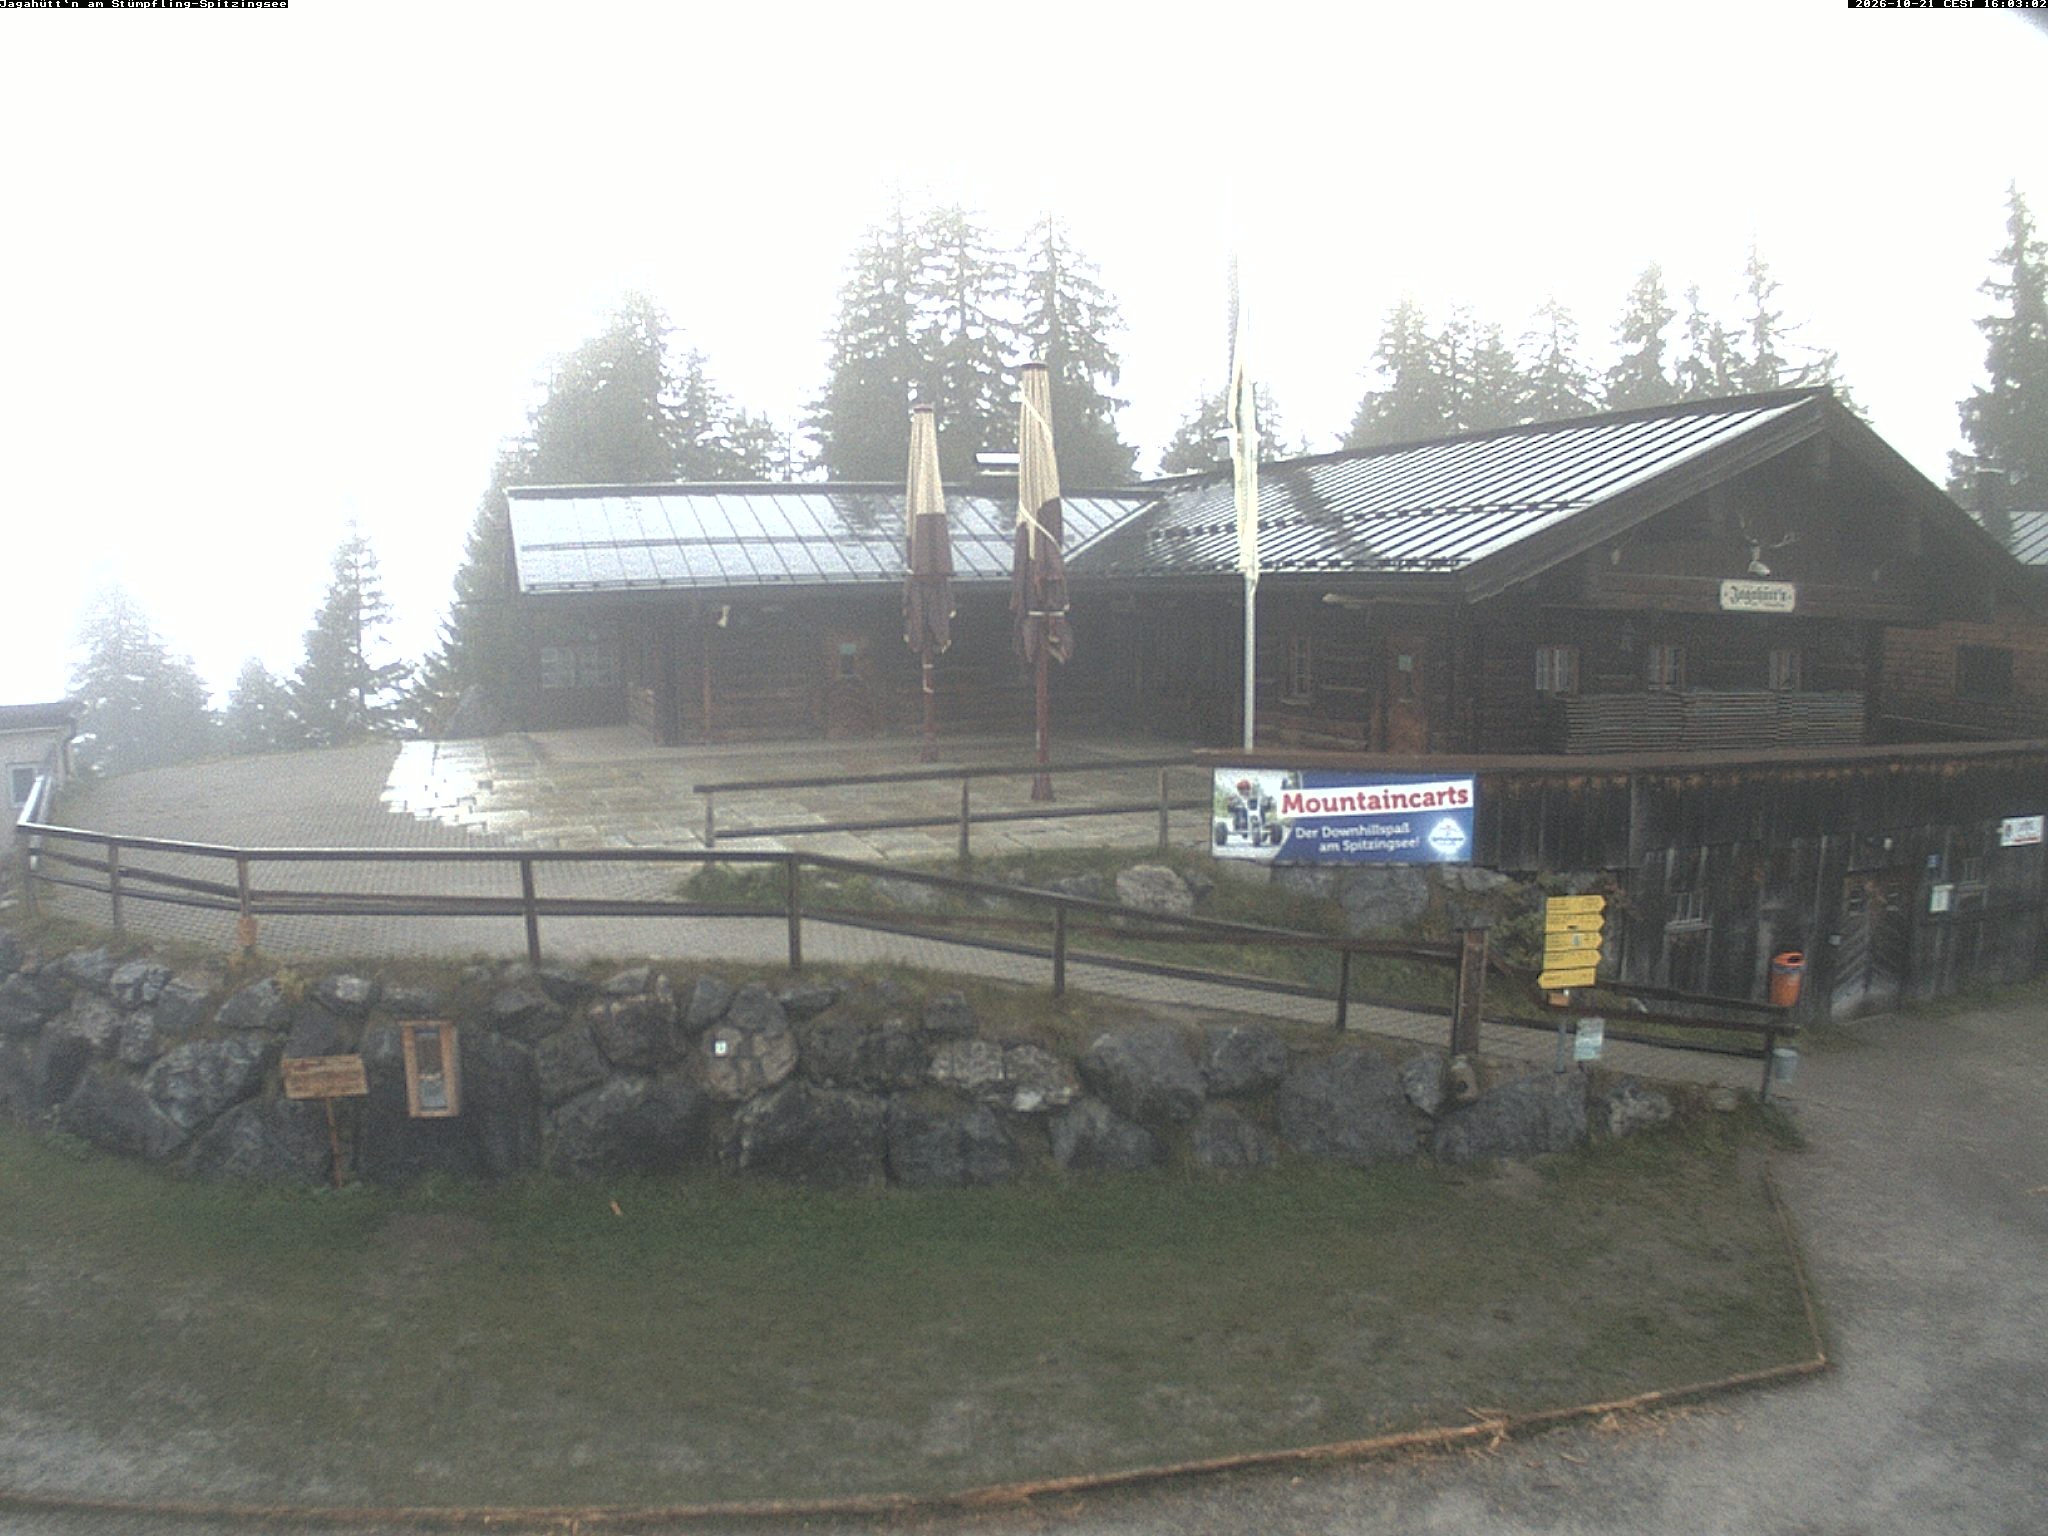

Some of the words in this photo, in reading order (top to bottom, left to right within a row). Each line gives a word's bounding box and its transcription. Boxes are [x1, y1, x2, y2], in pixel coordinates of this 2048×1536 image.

[1281, 786, 1470, 814] Mountaincarts
[1295, 826, 1319, 838] Der
[1321, 822, 1411, 839] Downhillspaß
[1318, 842, 1341, 852] am
[1341, 837, 1420, 853] Spitzingsee!
